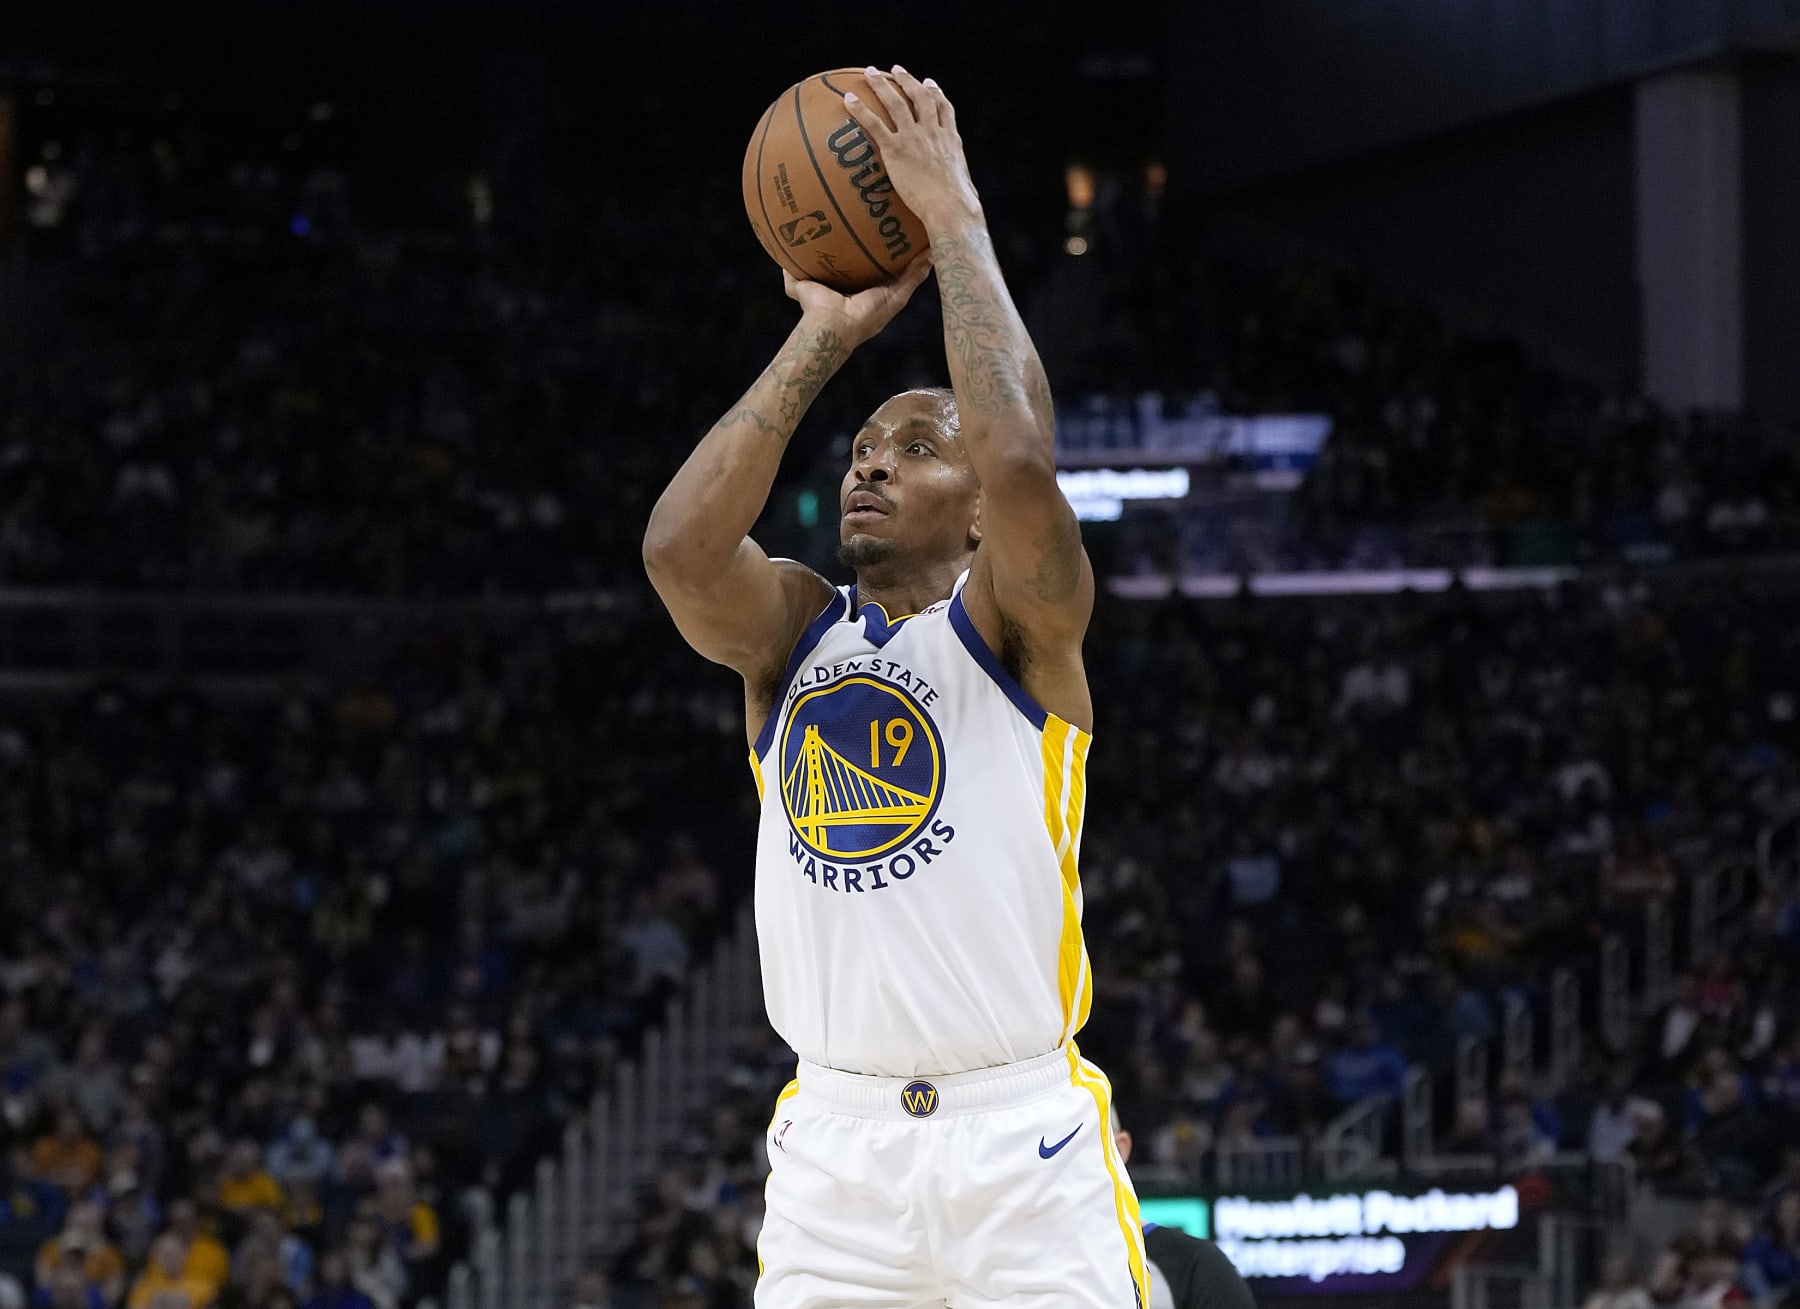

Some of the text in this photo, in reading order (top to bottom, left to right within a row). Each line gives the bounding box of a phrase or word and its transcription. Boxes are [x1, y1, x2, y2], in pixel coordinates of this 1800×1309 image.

[827, 117, 912, 261] Wilson
[869, 658, 940, 708] STATE
[870, 717, 914, 768] 19
[788, 818, 955, 893] WARRIORS
[903, 1090, 936, 1113] W
